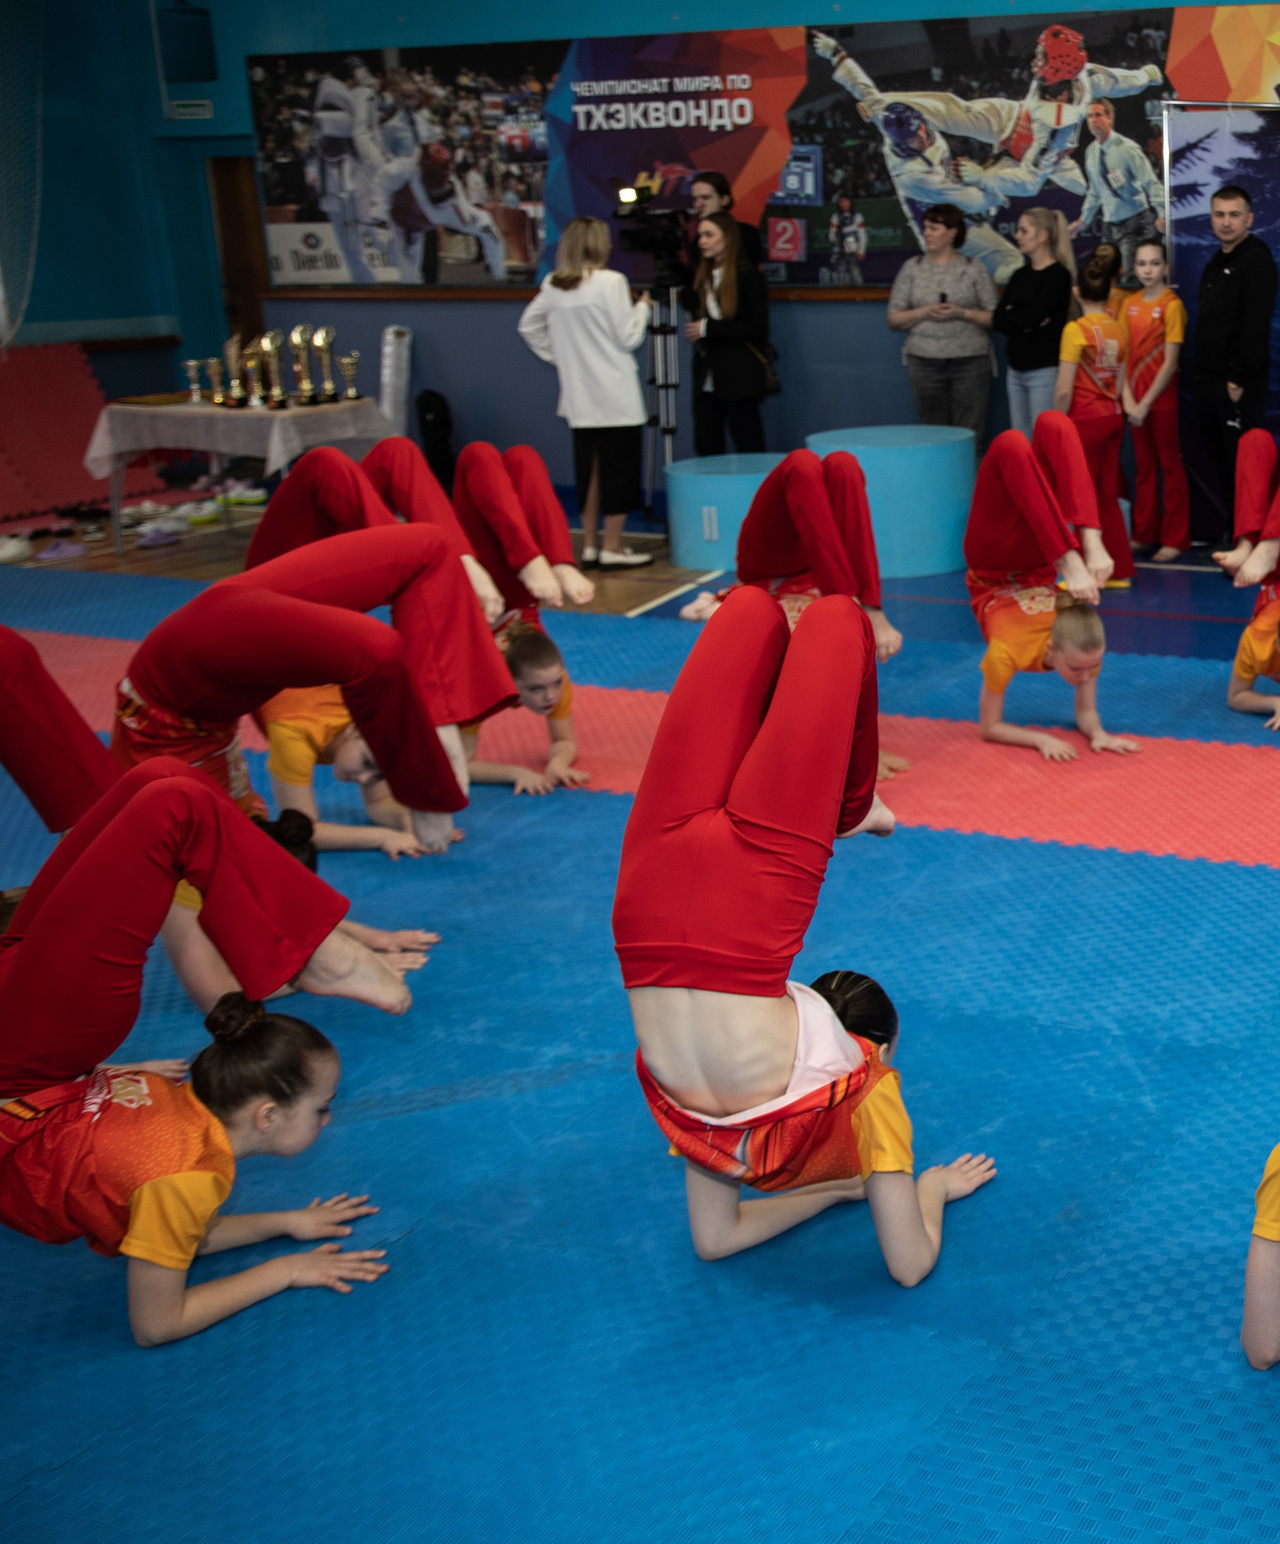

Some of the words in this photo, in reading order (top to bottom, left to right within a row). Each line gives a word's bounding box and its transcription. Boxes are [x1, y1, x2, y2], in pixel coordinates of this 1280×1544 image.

[570, 78, 671, 97] ЧЕМПИОНАТ
[673, 75, 724, 94] МИРА
[726, 74, 752, 90] ПО
[571, 97, 754, 132] ТХЭКВОНДО
[775, 221, 795, 249] 2
